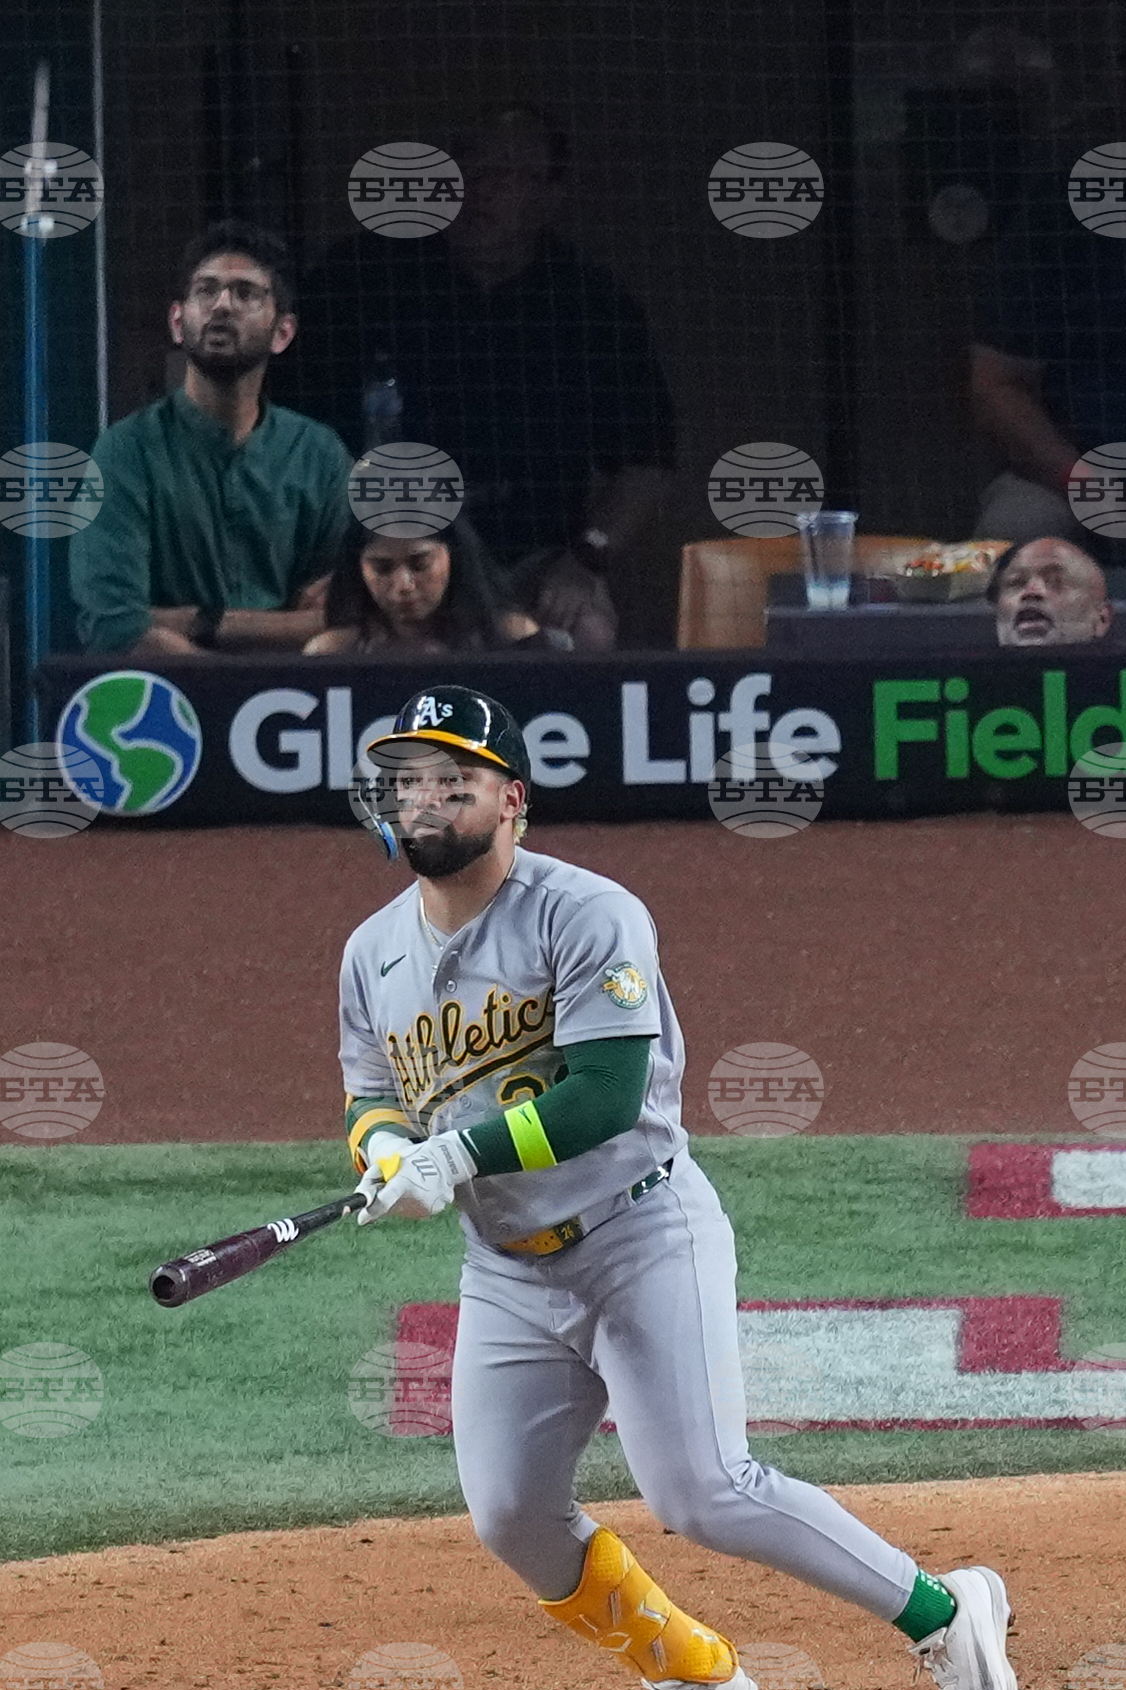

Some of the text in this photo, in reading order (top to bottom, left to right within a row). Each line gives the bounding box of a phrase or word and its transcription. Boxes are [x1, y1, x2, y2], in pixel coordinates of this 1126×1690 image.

[229, 685, 591, 794] Gle
[621, 673, 842, 785] Life
[418, 696, 453, 727] A's
[386, 983, 555, 1110] Athletic
